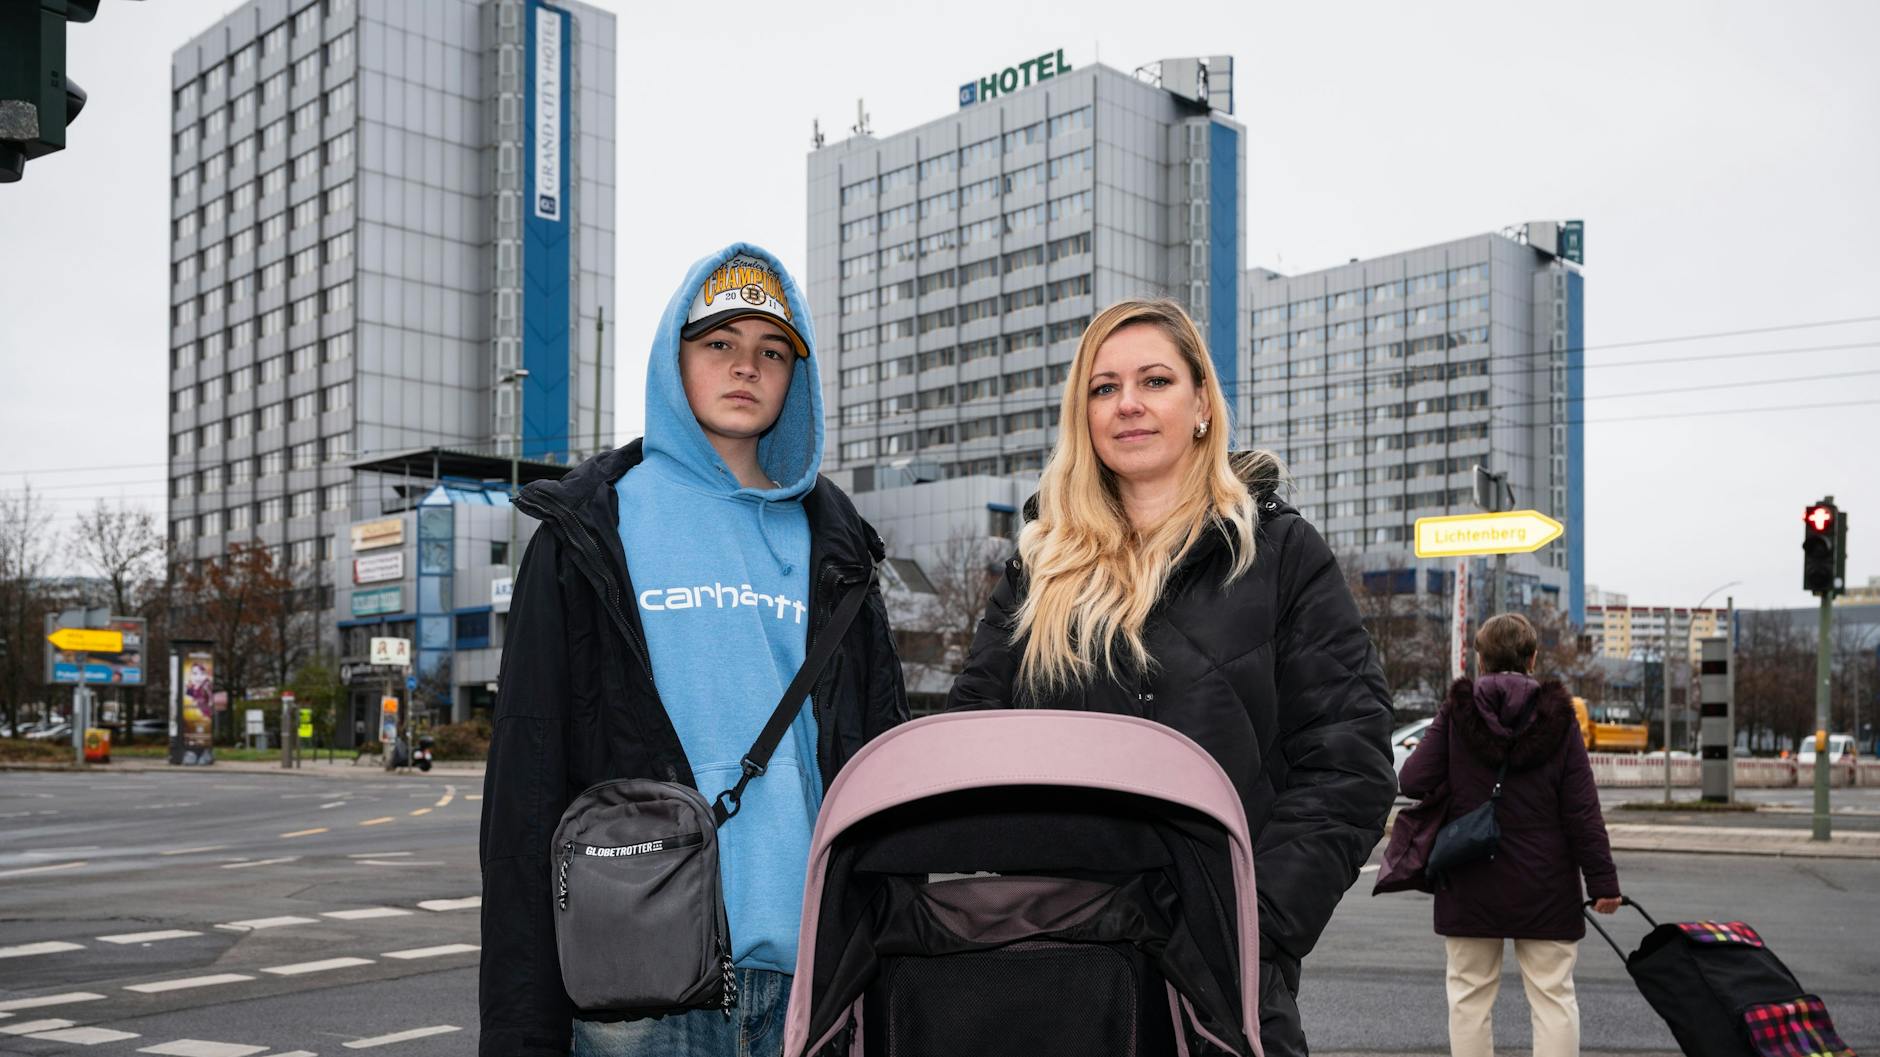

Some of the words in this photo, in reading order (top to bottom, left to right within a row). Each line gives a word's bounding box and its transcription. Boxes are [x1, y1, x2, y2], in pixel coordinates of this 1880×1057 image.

[541, 16, 556, 73] HOTEL
[980, 48, 1072, 103] HOTEL
[541, 76, 555, 121] CITY
[541, 124, 555, 191] GRAND
[732, 259, 764, 272] Stanley
[725, 292, 737, 301] 20
[1434, 527, 1527, 545] Lichtenberg
[639, 582, 807, 624] carhartt
[585, 842, 653, 857] GLOBETROTTER
